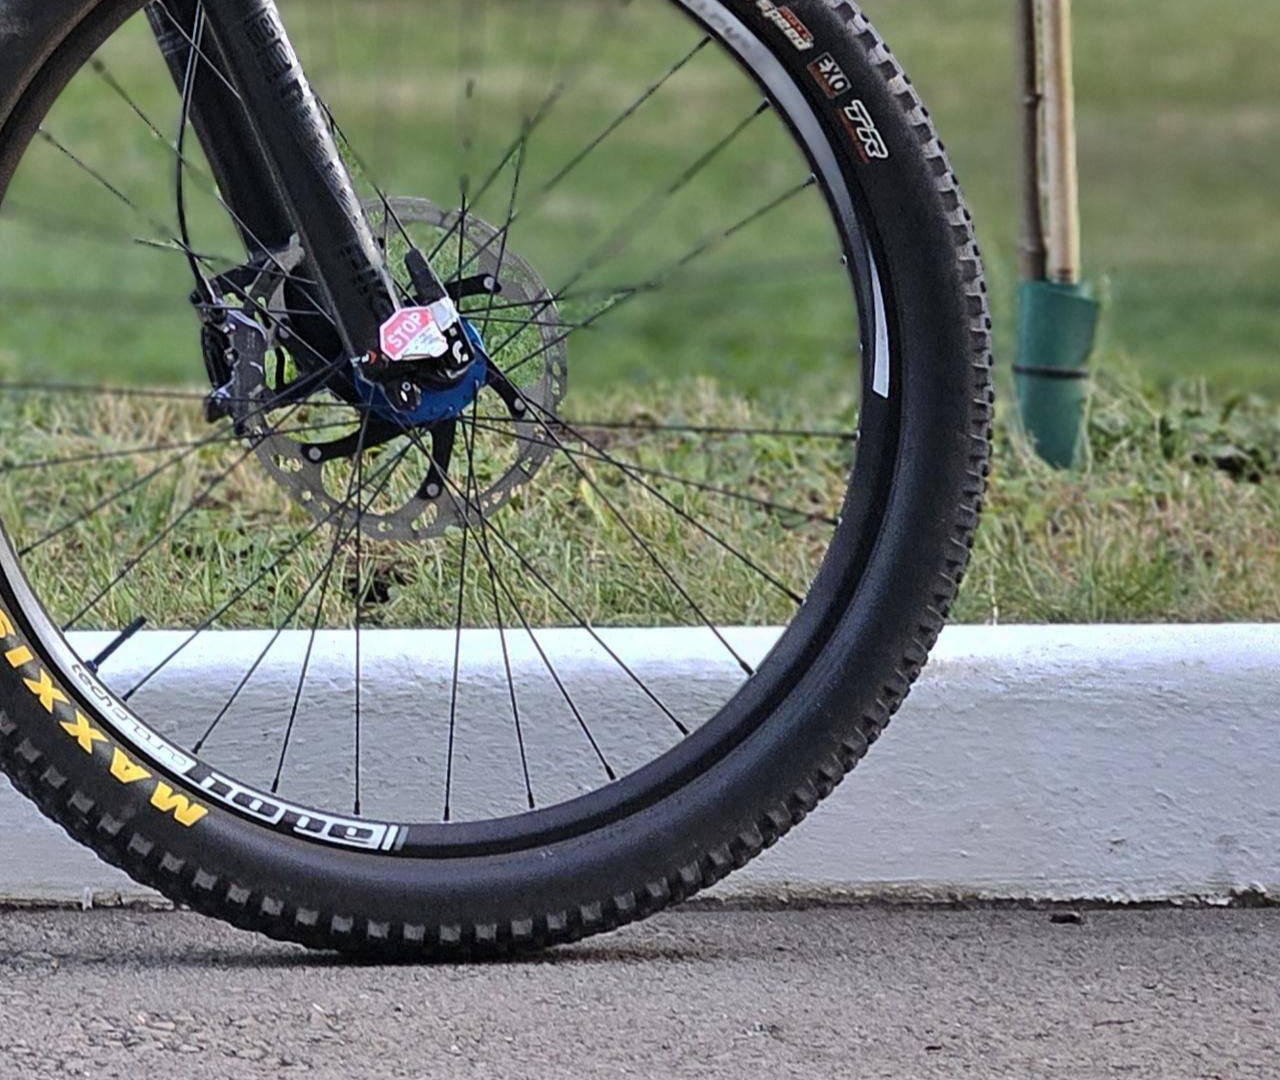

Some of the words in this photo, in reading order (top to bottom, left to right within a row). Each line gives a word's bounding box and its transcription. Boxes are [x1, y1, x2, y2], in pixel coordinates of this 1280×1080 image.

[816, 54, 852, 94] EXO
[844, 99, 889, 159] TR
[387, 311, 424, 349] STOP
